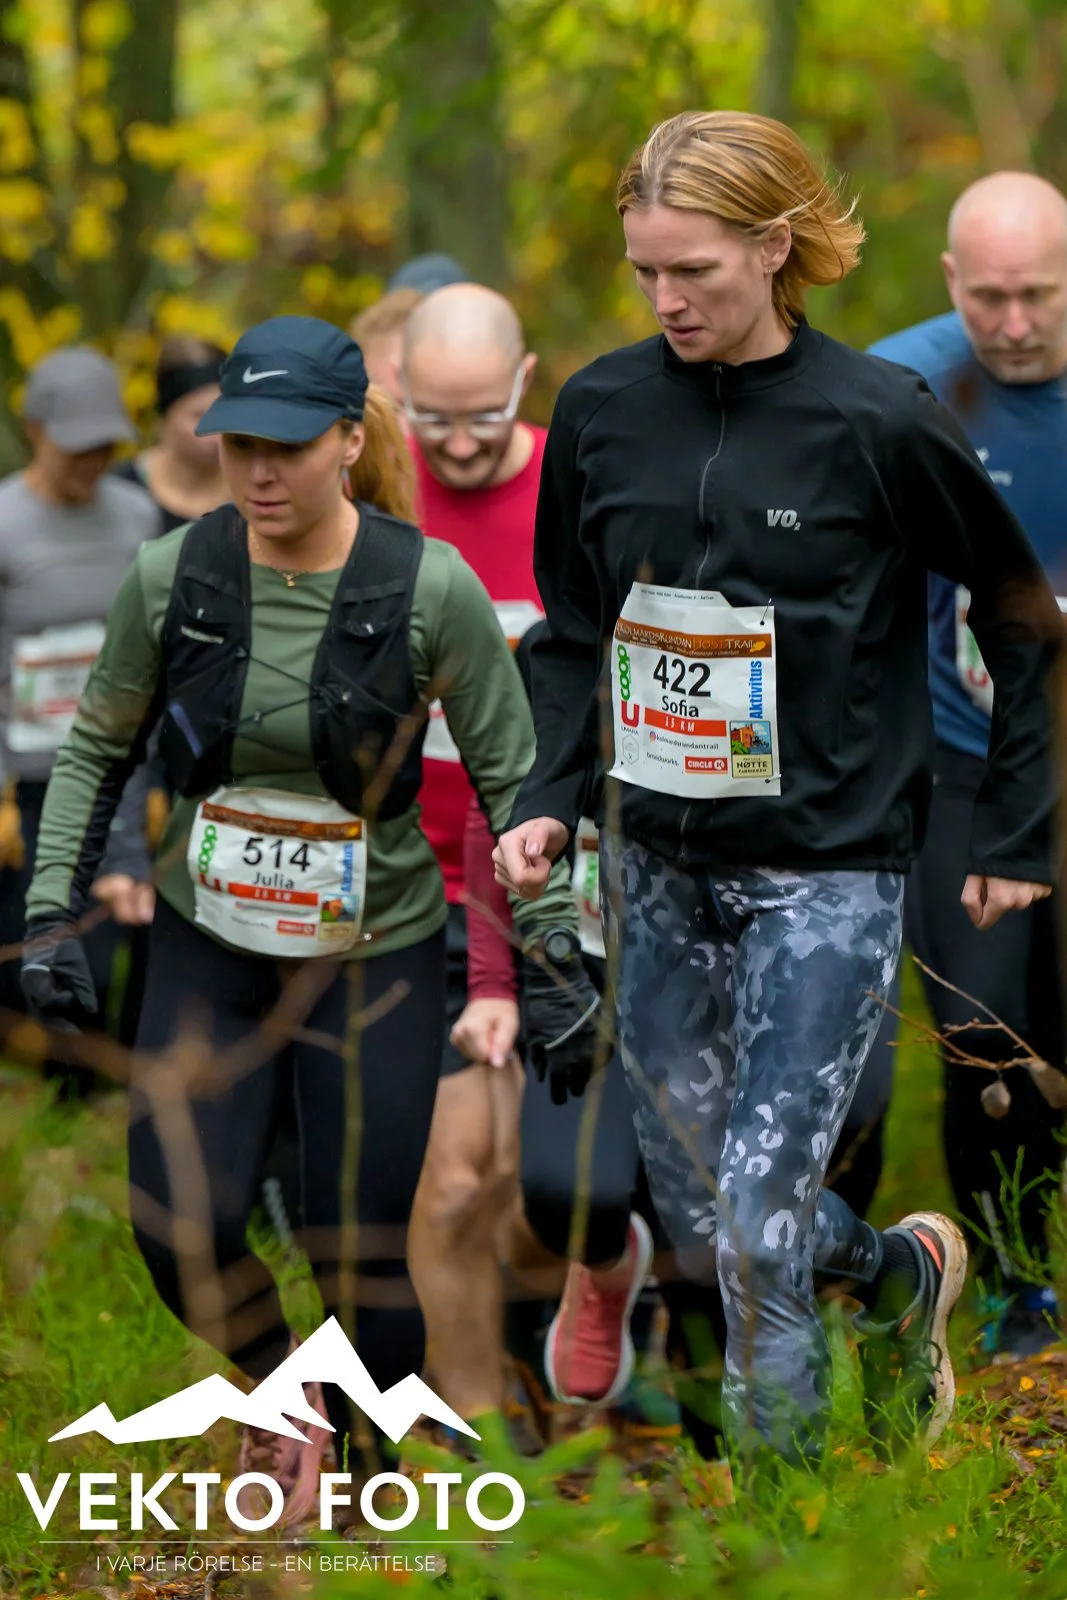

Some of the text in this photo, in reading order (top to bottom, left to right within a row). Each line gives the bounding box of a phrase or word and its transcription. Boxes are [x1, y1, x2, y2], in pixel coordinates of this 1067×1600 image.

[617, 644, 631, 702] coop
[653, 655, 712, 698] 422
[748, 660, 763, 719] Aktivitus
[662, 696, 700, 718] Sofia
[664, 715, 696, 733] 15 KM
[687, 760, 713, 770] CIRCLE
[736, 760, 768, 770] NØTTE
[242, 836, 311, 873] 514
[251, 872, 296, 890] Julia
